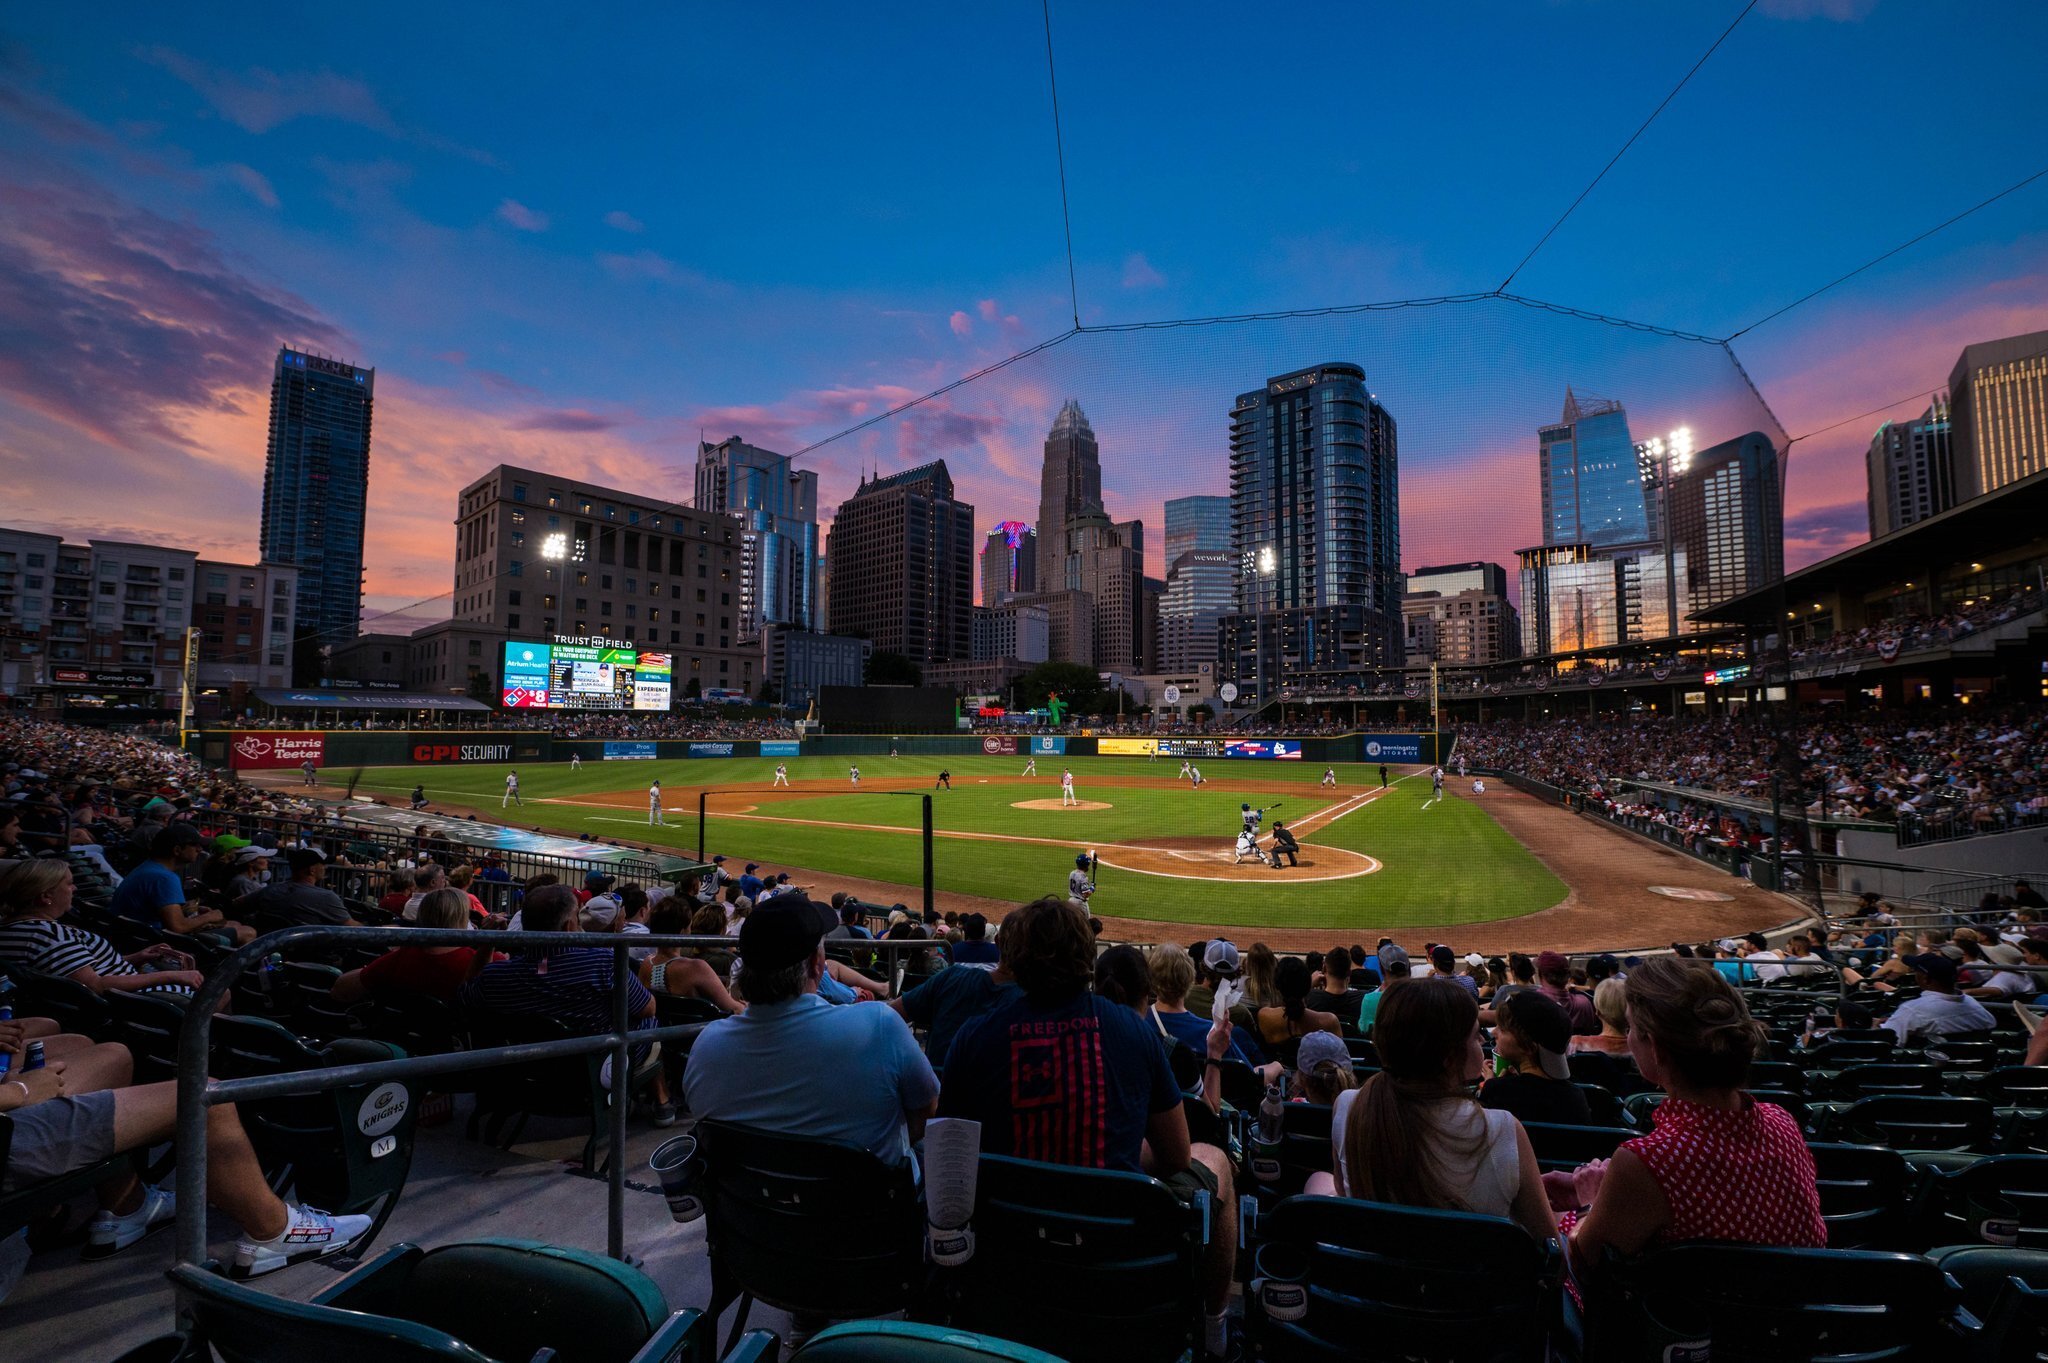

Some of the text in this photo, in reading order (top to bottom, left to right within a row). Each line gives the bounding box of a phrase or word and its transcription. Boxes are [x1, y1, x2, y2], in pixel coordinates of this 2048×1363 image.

[1194, 553, 1228, 562] wework
[554, 634, 633, 649] TRUIST FIELD
[507, 660, 548, 669] Atrium Health
[274, 737, 322, 748] Harris
[1382, 744, 1418, 752] morningstar
[274, 748, 321, 759] Teeter
[413, 744, 510, 761] CPI SECURITY
[1009, 1015, 1100, 1038] FREEDOM
[363, 1100, 405, 1130] KNIGHTS
[377, 1139, 391, 1155] M
